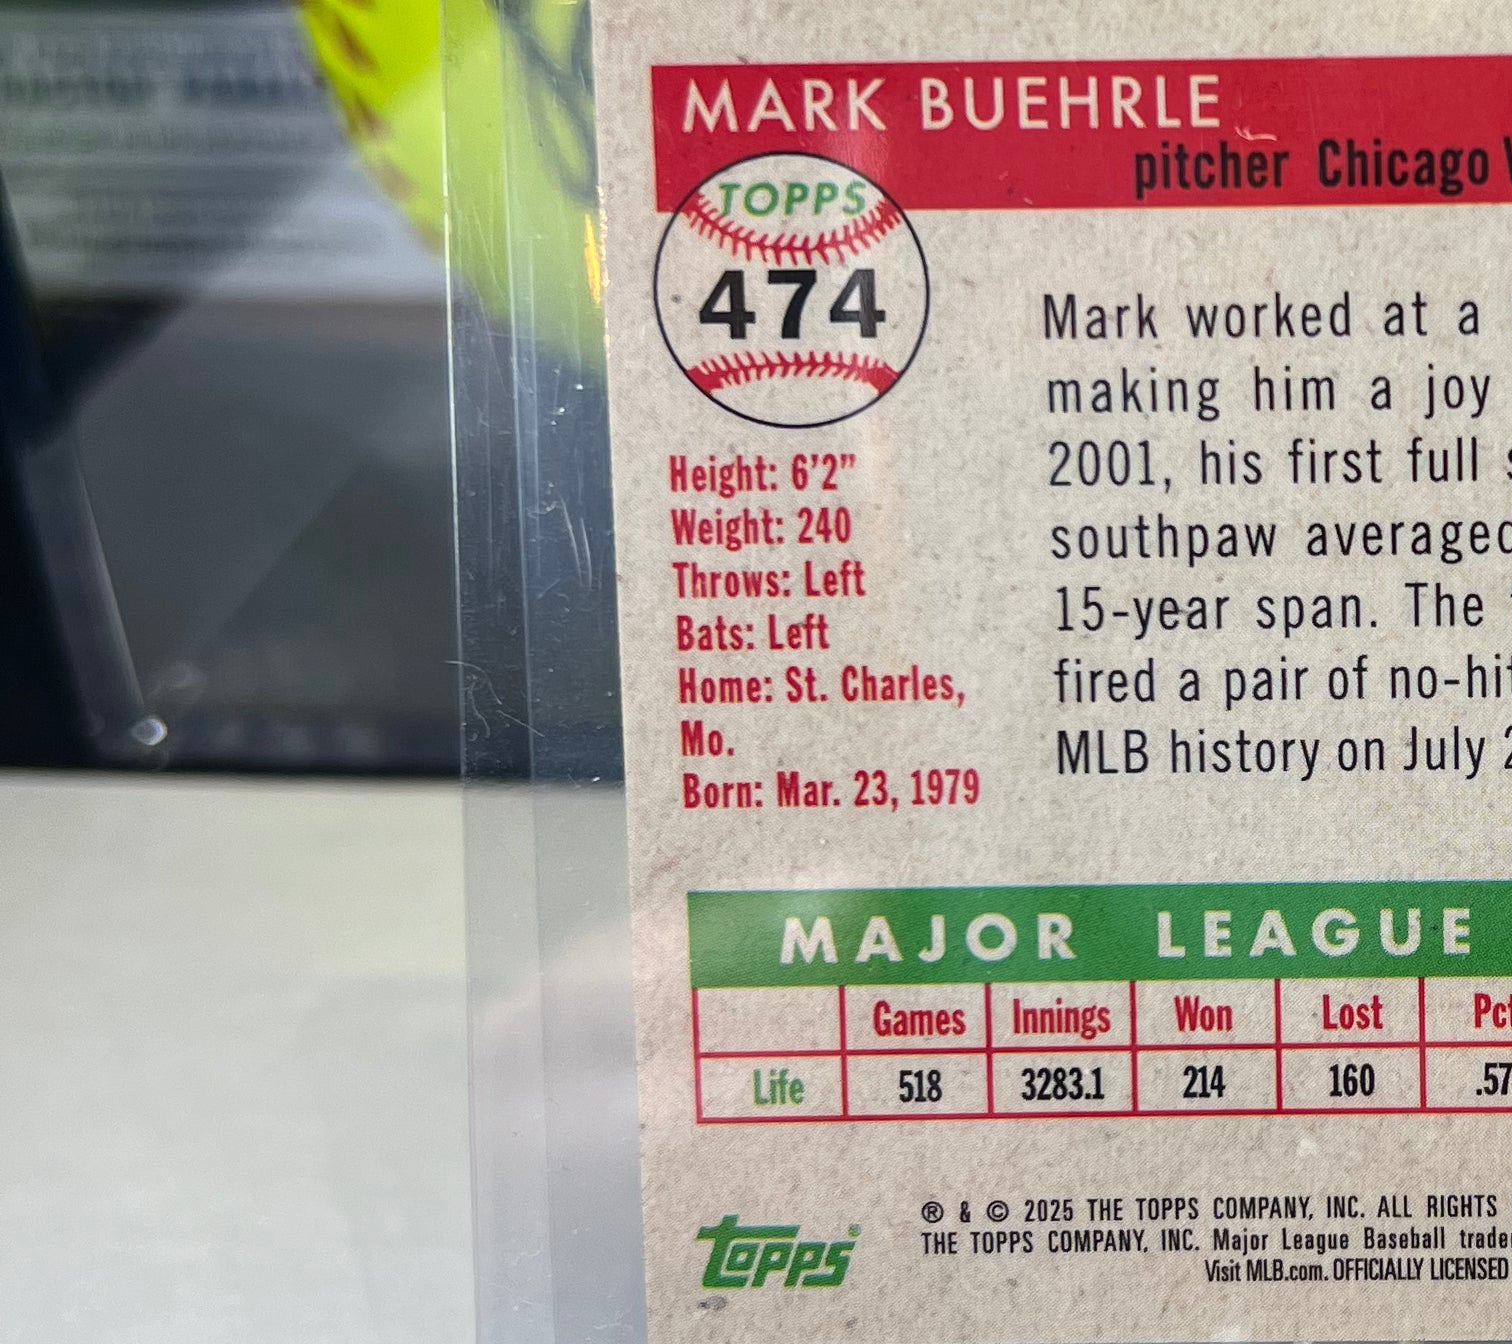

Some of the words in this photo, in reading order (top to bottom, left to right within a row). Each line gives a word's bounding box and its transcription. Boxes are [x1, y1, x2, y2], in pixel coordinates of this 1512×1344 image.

[684, 79, 886, 132] MARK
[921, 75, 1220, 130] BUEHRLE
[1134, 140, 1290, 200] pitcher
[1318, 138, 1489, 197] Chicago
[720, 181, 865, 216] TOPPS
[698, 268, 886, 340] 474
[1043, 293, 1158, 340] Mark
[1186, 290, 1351, 338] worked
[1383, 291, 1428, 336] at
[1458, 300, 1479, 336] a
[1048, 367, 1220, 422] making
[1254, 365, 1335, 411] him
[1370, 376, 1392, 411] a
[1424, 363, 1491, 420] joy
[668, 455, 778, 500] Height:
[1049, 440, 1171, 493] 2001,
[1200, 439, 1262, 485] his
[1287, 437, 1382, 484] first
[1406, 436, 1478, 483] full
[670, 508, 784, 553] Weight:
[797, 506, 852, 545] 240
[671, 561, 791, 599] Throws:
[804, 559, 866, 598] Left
[675, 614, 755, 653] Bats:
[767, 612, 830, 651] Left
[1056, 586, 1230, 641] 15-year
[1256, 594, 1377, 639] span.
[1404, 582, 1484, 627] The
[678, 667, 773, 705] Home:
[785, 665, 828, 704] St.
[840, 665, 965, 706] Charles,
[680, 719, 734, 757] Mo.
[1057, 729, 1149, 775] MLB
[1171, 728, 1320, 781] history
[1337, 738, 1385, 772] on
[1403, 725, 1486, 780] July
[682, 772, 763, 810] Born:
[775, 771, 840, 808] Mar.
[853, 769, 899, 811] 23,
[911, 768, 980, 807] 1979
[779, 914, 1077, 965] MAJOR
[1157, 907, 1470, 958] LEAGUE
[872, 1000, 967, 1038] Games
[1012, 998, 1112, 1041] Innings
[1173, 996, 1233, 1033] Won
[1322, 994, 1384, 1031] Lost
[755, 1071, 804, 1104] Life
[899, 1069, 943, 1103] 518
[1021, 1066, 1105, 1101] 3283.1
[1182, 1064, 1227, 1099] 214
[1329, 1063, 1375, 1097] 160
[1024, 1198, 1074, 1223] 2025
[1086, 1198, 1123, 1222] THE
[1135, 1196, 1199, 1221] TOPPS
[1326, 1195, 1365, 1219] INC.
[1377, 1195, 1413, 1218] ALL
[1426, 1195, 1498, 1218] RIGHTS
[920, 1231, 958, 1255] THE
[969, 1230, 1034, 1254] TOPPS
[1161, 1228, 1200, 1252] INC.
[1213, 1227, 1269, 1256] Major
[1281, 1227, 1350, 1256] League
[1363, 1226, 1446, 1250] Baseball
[1204, 1259, 1242, 1283] Visit
[1246, 1258, 1329, 1282] MLB.com.
[1333, 1258, 1424, 1281] OFFICIALLY
[1430, 1258, 1509, 1281] LICENSED
